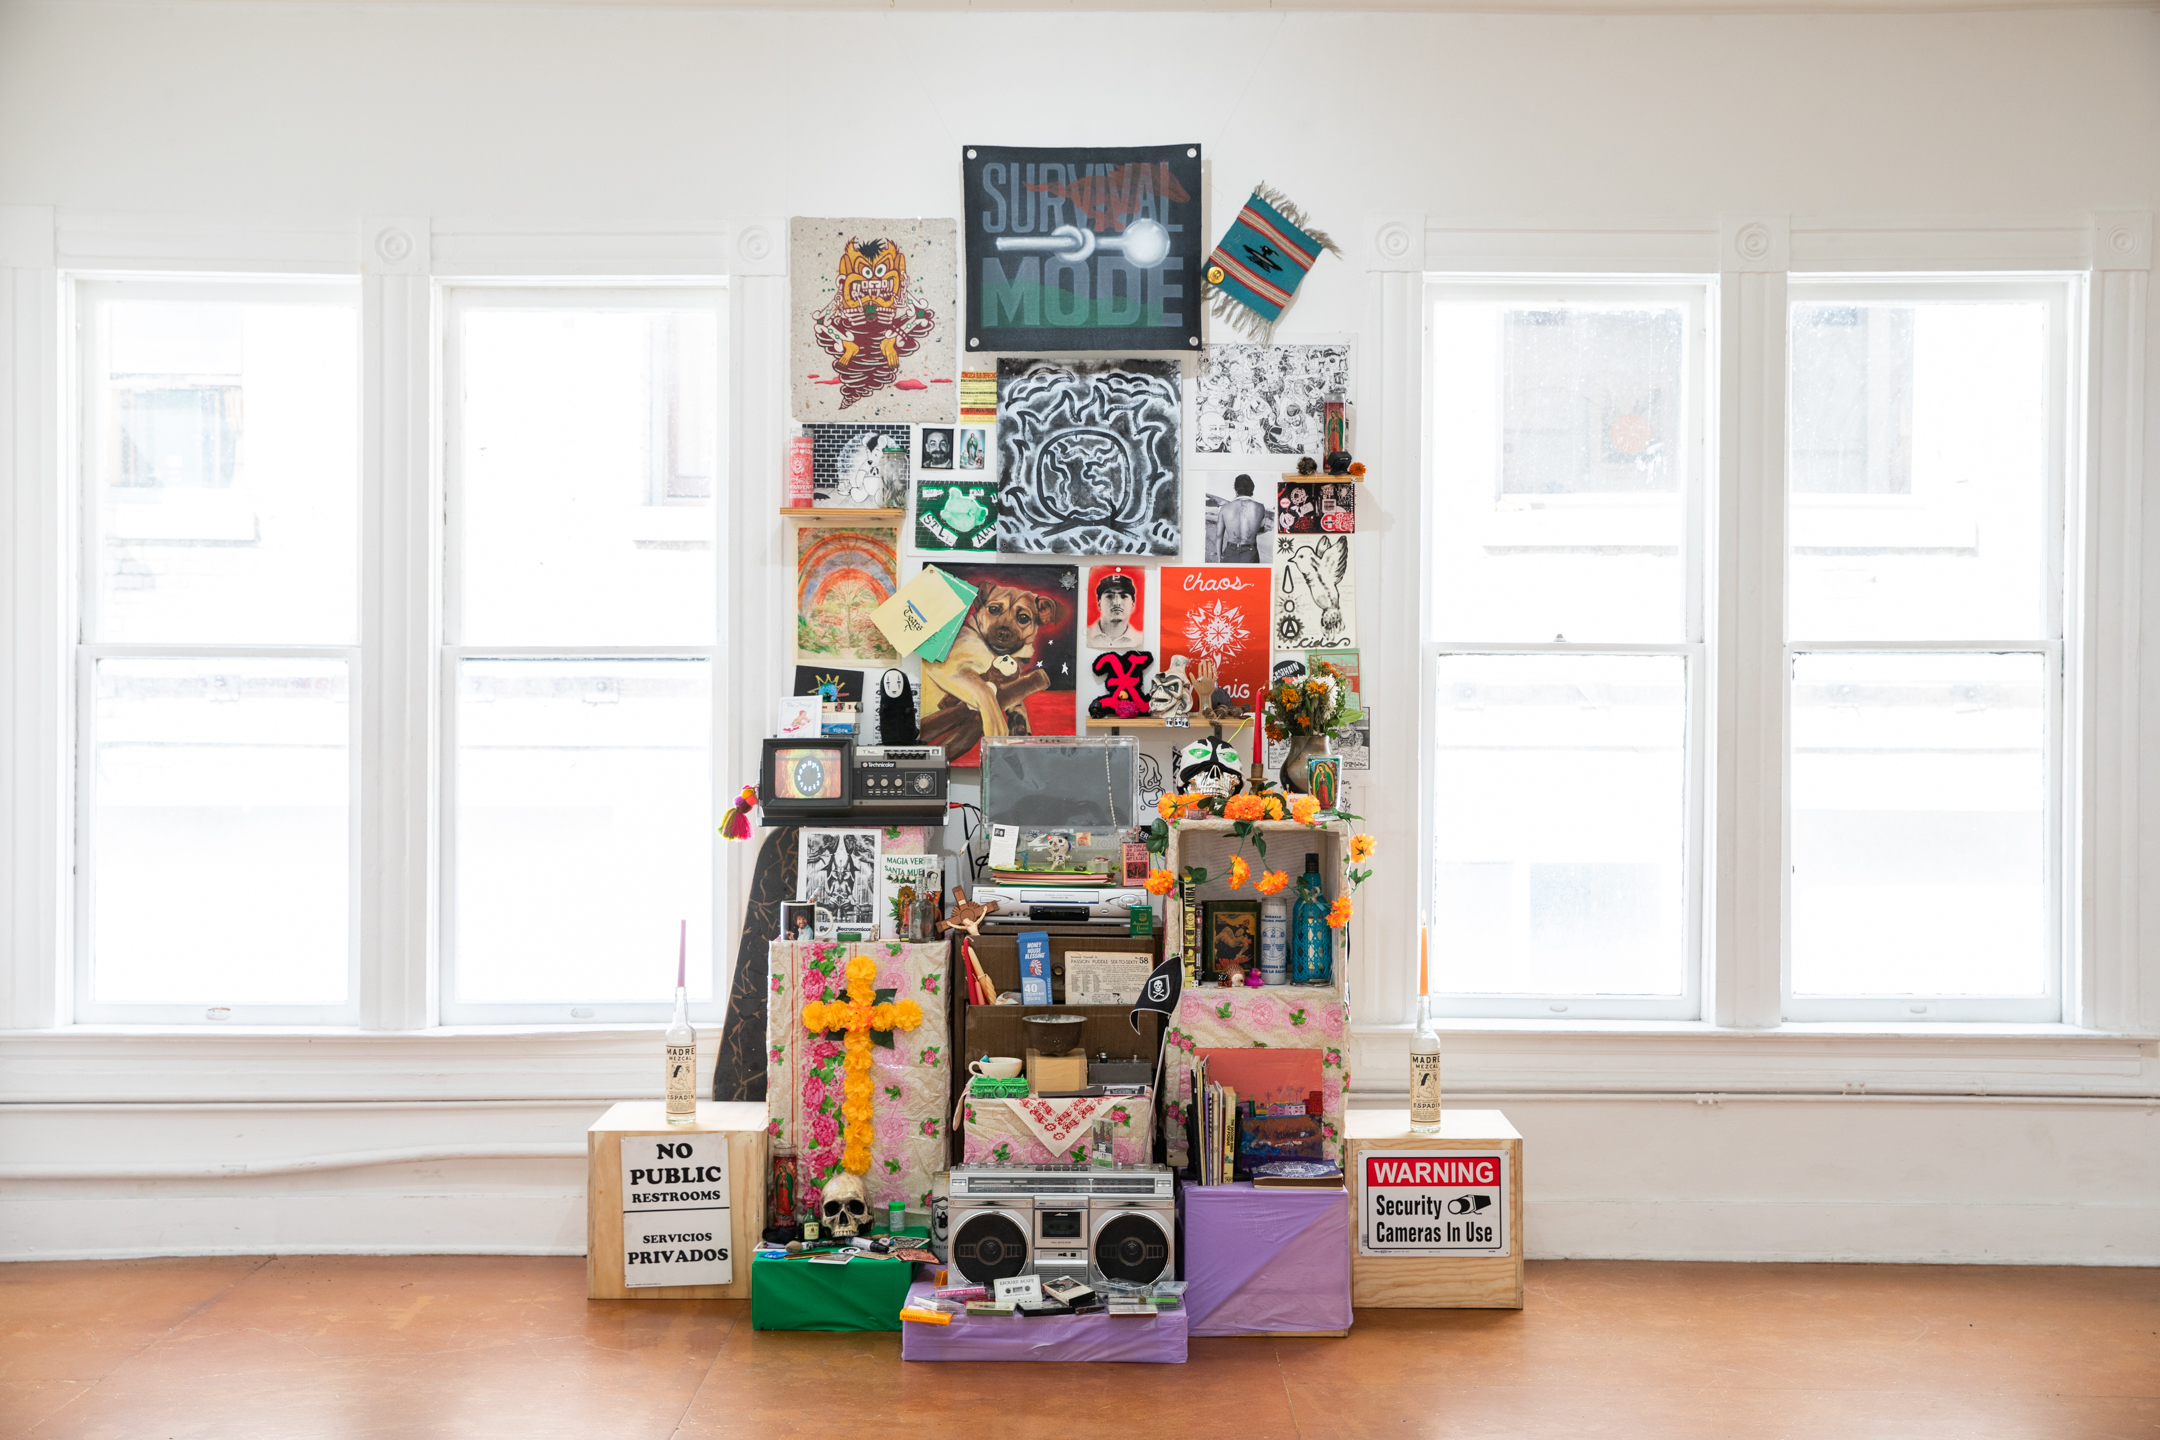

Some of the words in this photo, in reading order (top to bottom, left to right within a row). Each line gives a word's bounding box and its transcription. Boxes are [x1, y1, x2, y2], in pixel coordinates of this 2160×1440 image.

[982, 161, 1184, 233] SURVIVAL
[982, 256, 1184, 328] MODE
[1183, 572, 1254, 592] Chaos
[886, 857, 909, 865] MAGIA
[885, 865, 905, 876] SANTA
[1024, 952, 1045, 960] BLESSING
[1139, 957, 1149, 965] 58
[1024, 983, 1038, 993] 40
[667, 1048, 695, 1056] MADRE
[1412, 1056, 1440, 1064] MADRE
[656, 1142, 694, 1160] NO
[630, 1166, 722, 1185] PUBLIC
[1373, 1161, 1494, 1184] WARNING
[632, 1190, 721, 1204] RESTROOMS
[1376, 1194, 1442, 1220] Security
[642, 1232, 713, 1245] SERVICIOS
[1376, 1222, 1442, 1243] Cameras
[1447, 1221, 1461, 1243] In
[1466, 1222, 1493, 1243] Use
[627, 1248, 729, 1265] PRIVADOS
